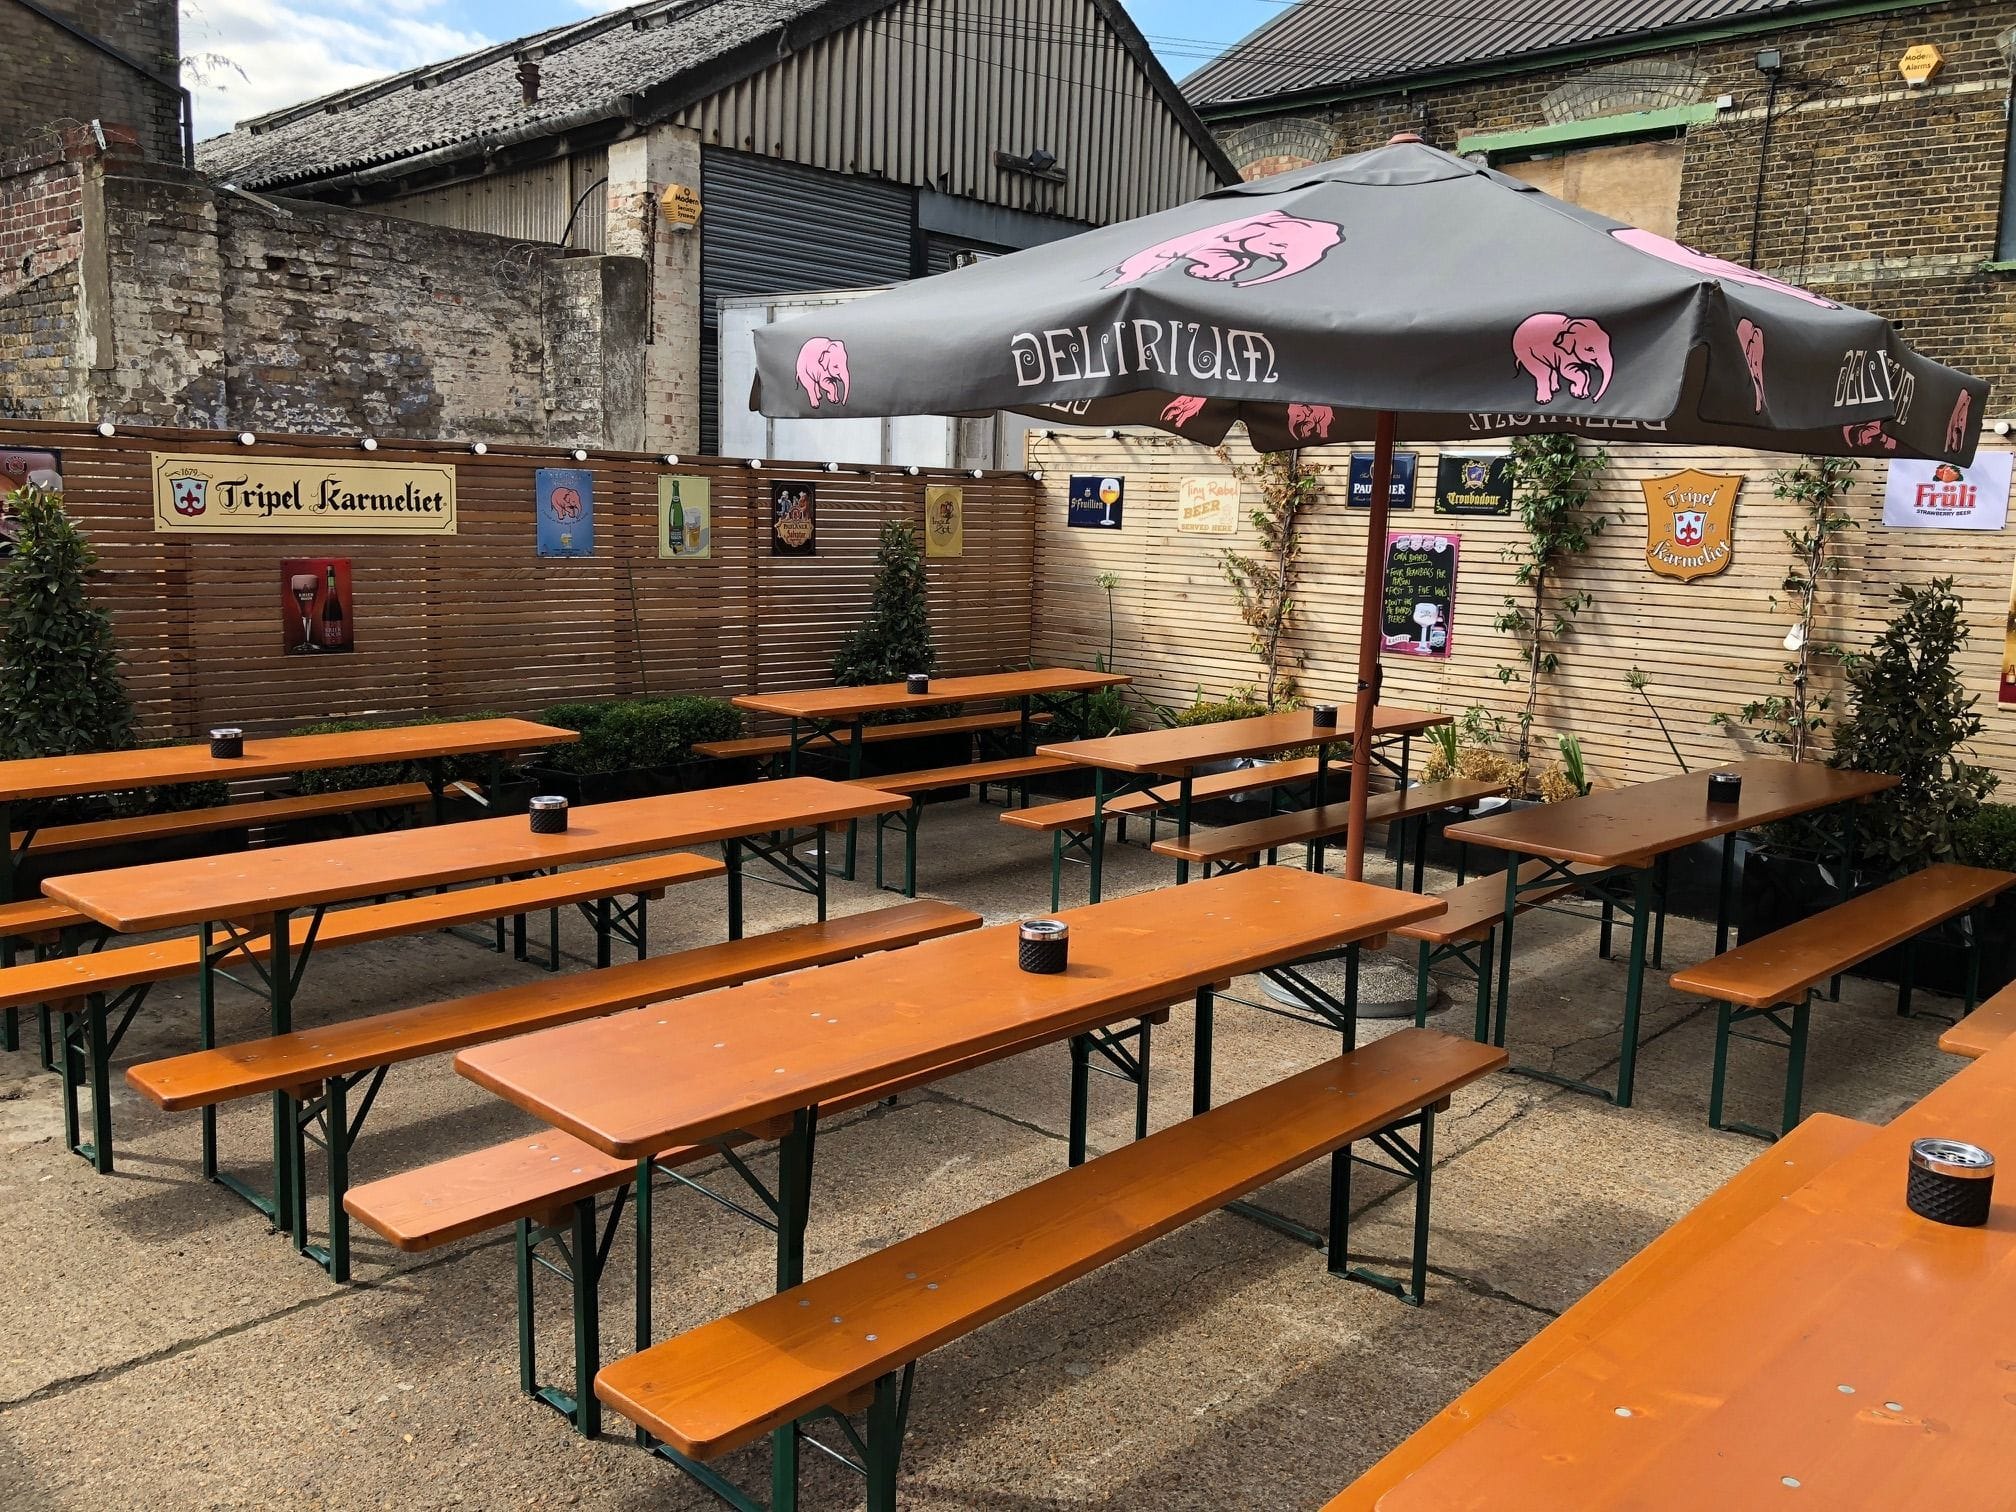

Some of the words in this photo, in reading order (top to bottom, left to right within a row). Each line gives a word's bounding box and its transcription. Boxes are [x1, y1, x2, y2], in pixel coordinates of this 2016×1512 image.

[675, 194, 699, 205] Modern
[1010, 318, 1279, 387] DELIRIUM
[181, 467, 198, 476] 1679
[215, 474, 303, 518] Tripel
[309, 473, 443, 514] Karmeliet
[1182, 480, 1205, 503] Tiny
[1353, 483, 1406, 495] PAUER
[1446, 490, 1502, 506] Troubadour
[1664, 484, 1720, 509] Tripel
[1913, 482, 1977, 508] Früli
[1183, 500, 1220, 519] BEER
[1647, 539, 1730, 567] Karmeliet
